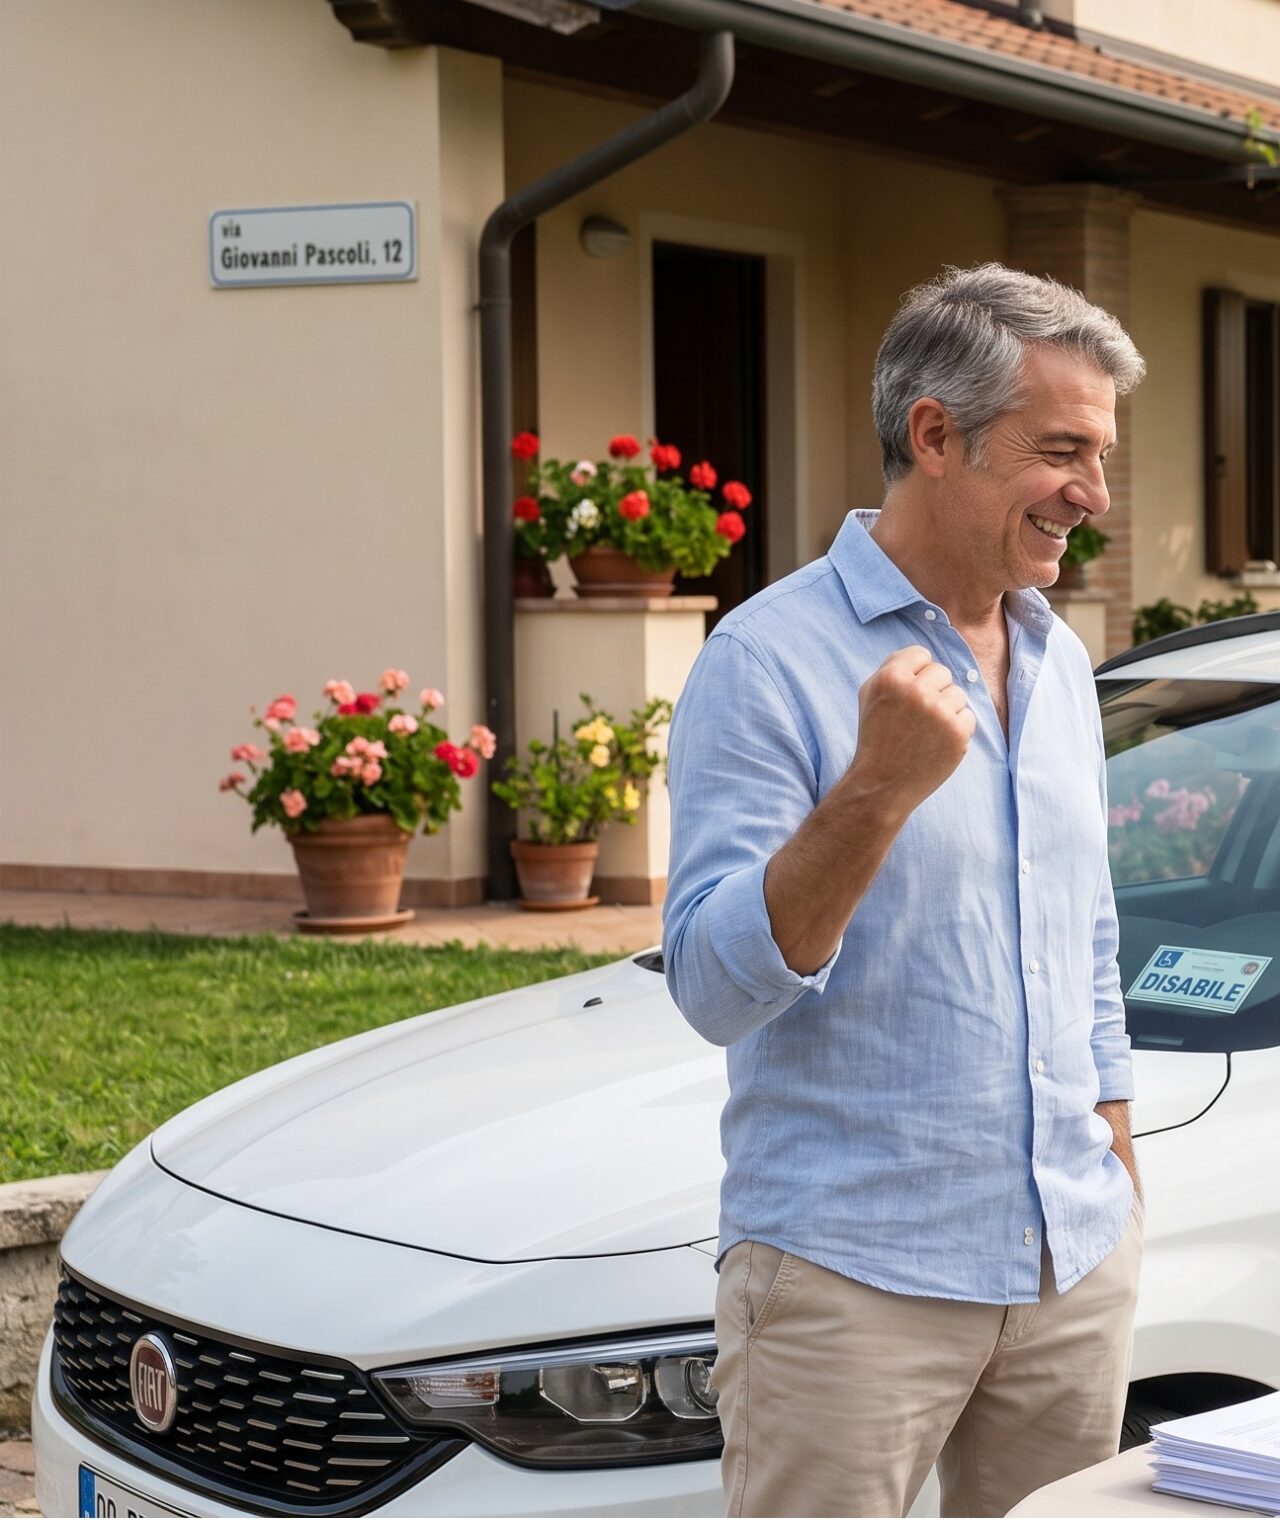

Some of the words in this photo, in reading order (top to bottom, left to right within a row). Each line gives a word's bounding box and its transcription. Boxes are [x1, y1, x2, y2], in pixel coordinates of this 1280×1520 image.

[221, 219, 242, 238] via
[221, 243, 298, 270] Giovanni
[383, 239, 403, 264] 12
[1140, 972, 1246, 1002] DISABILE
[138, 1361, 165, 1412] FIAT
